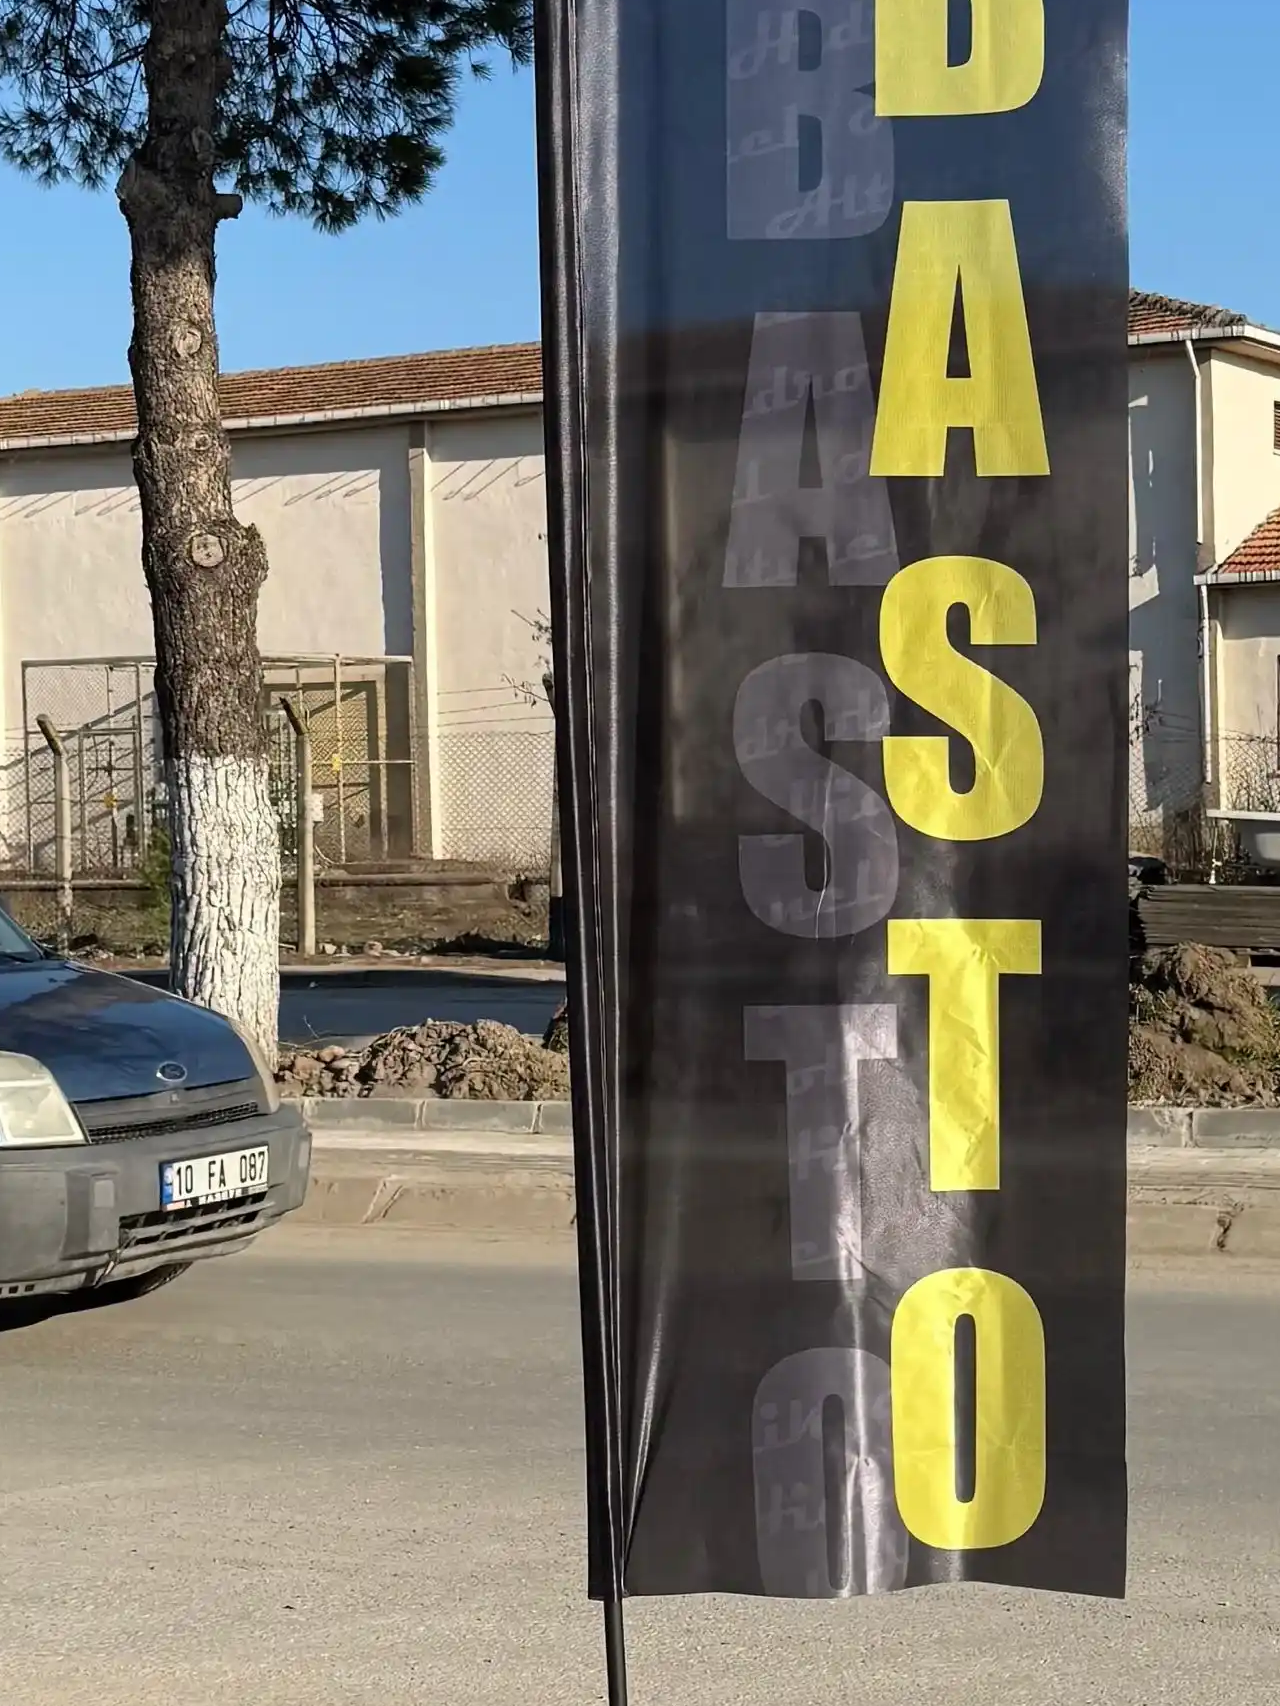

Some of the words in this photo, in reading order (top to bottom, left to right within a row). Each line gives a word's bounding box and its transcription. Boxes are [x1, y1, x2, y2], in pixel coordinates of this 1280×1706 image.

[176, 1164, 193, 1197] 10
[208, 1158, 227, 1190] FA
[240, 1151, 265, 1183] 087
